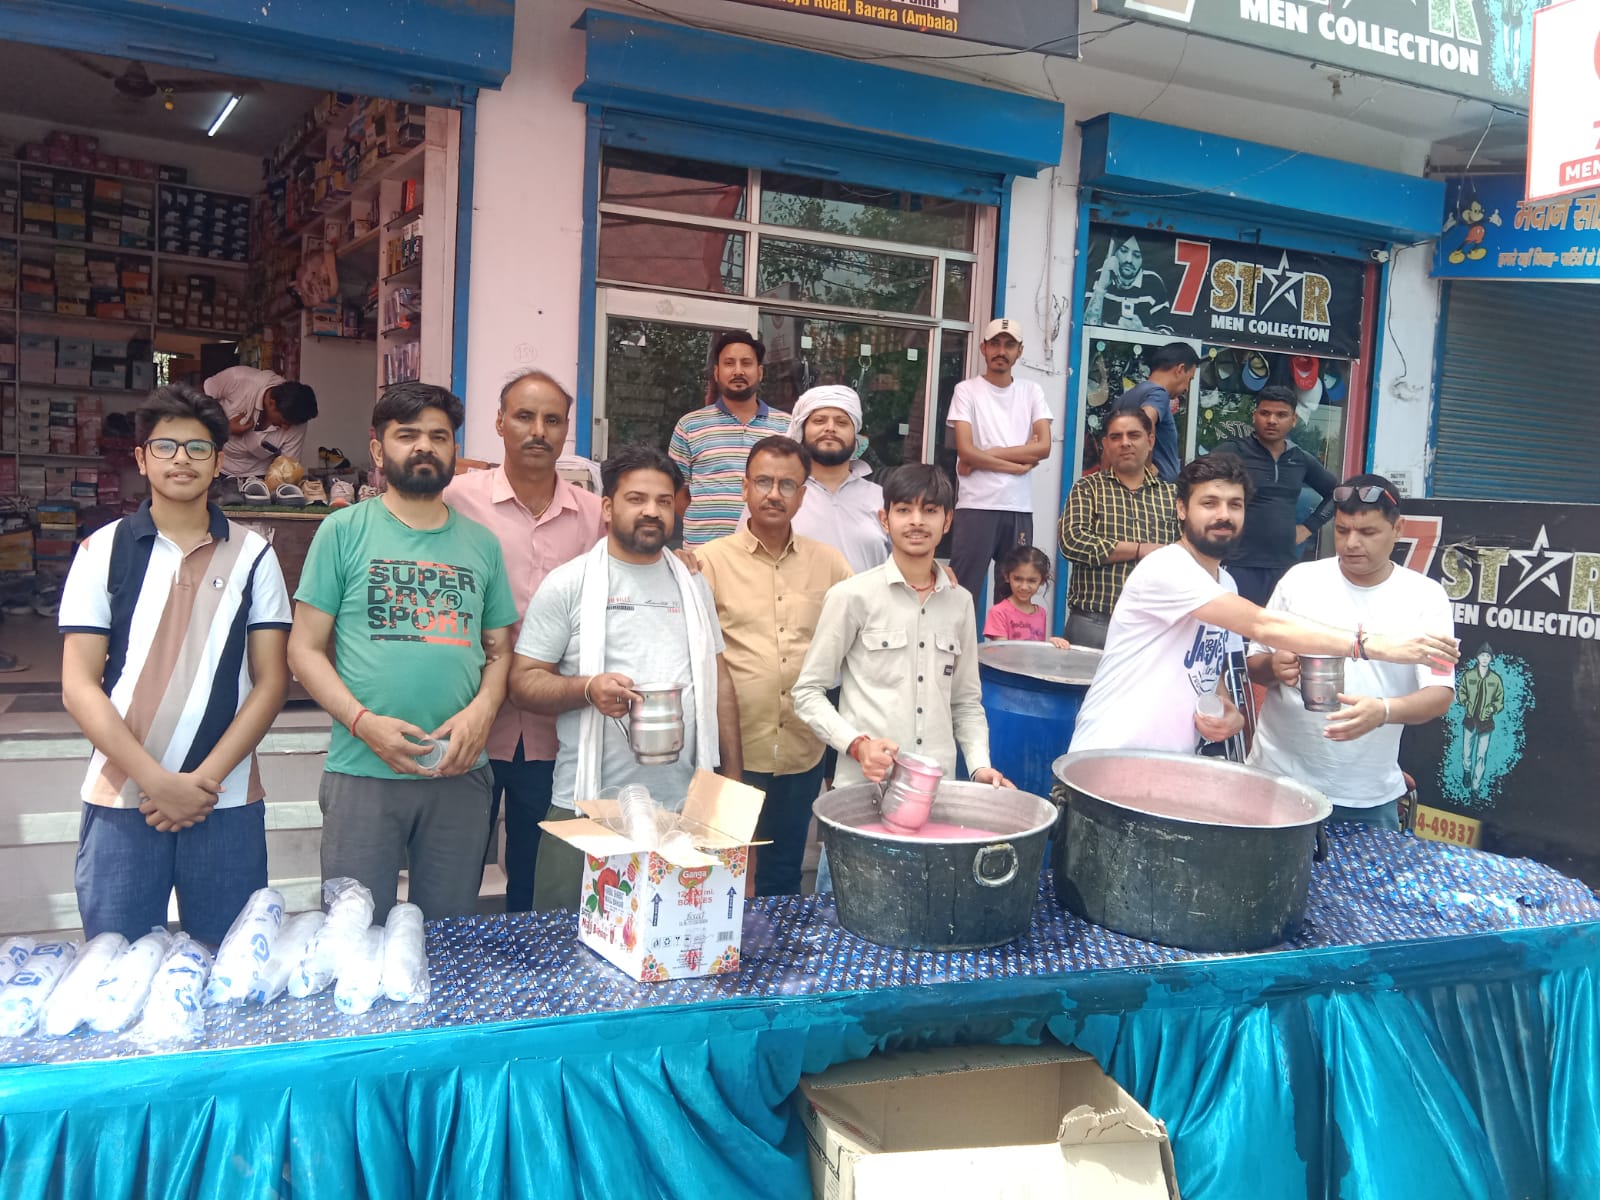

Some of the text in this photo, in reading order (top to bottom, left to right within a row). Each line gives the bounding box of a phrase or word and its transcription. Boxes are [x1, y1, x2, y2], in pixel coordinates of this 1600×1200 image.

[855, 1, 898, 22] Barara
[902, 9, 958, 33] (Ambala)
[1240, 0, 1308, 34] MEN
[1318, 12, 1479, 76] COLLECTION
[1170, 239, 1210, 316] 7
[1211, 314, 1330, 343] MEN COLLECTION
[368, 565, 476, 594] SUPER
[368, 606, 474, 636] SPORT
[1485, 606, 1600, 641] COLLECTIO
